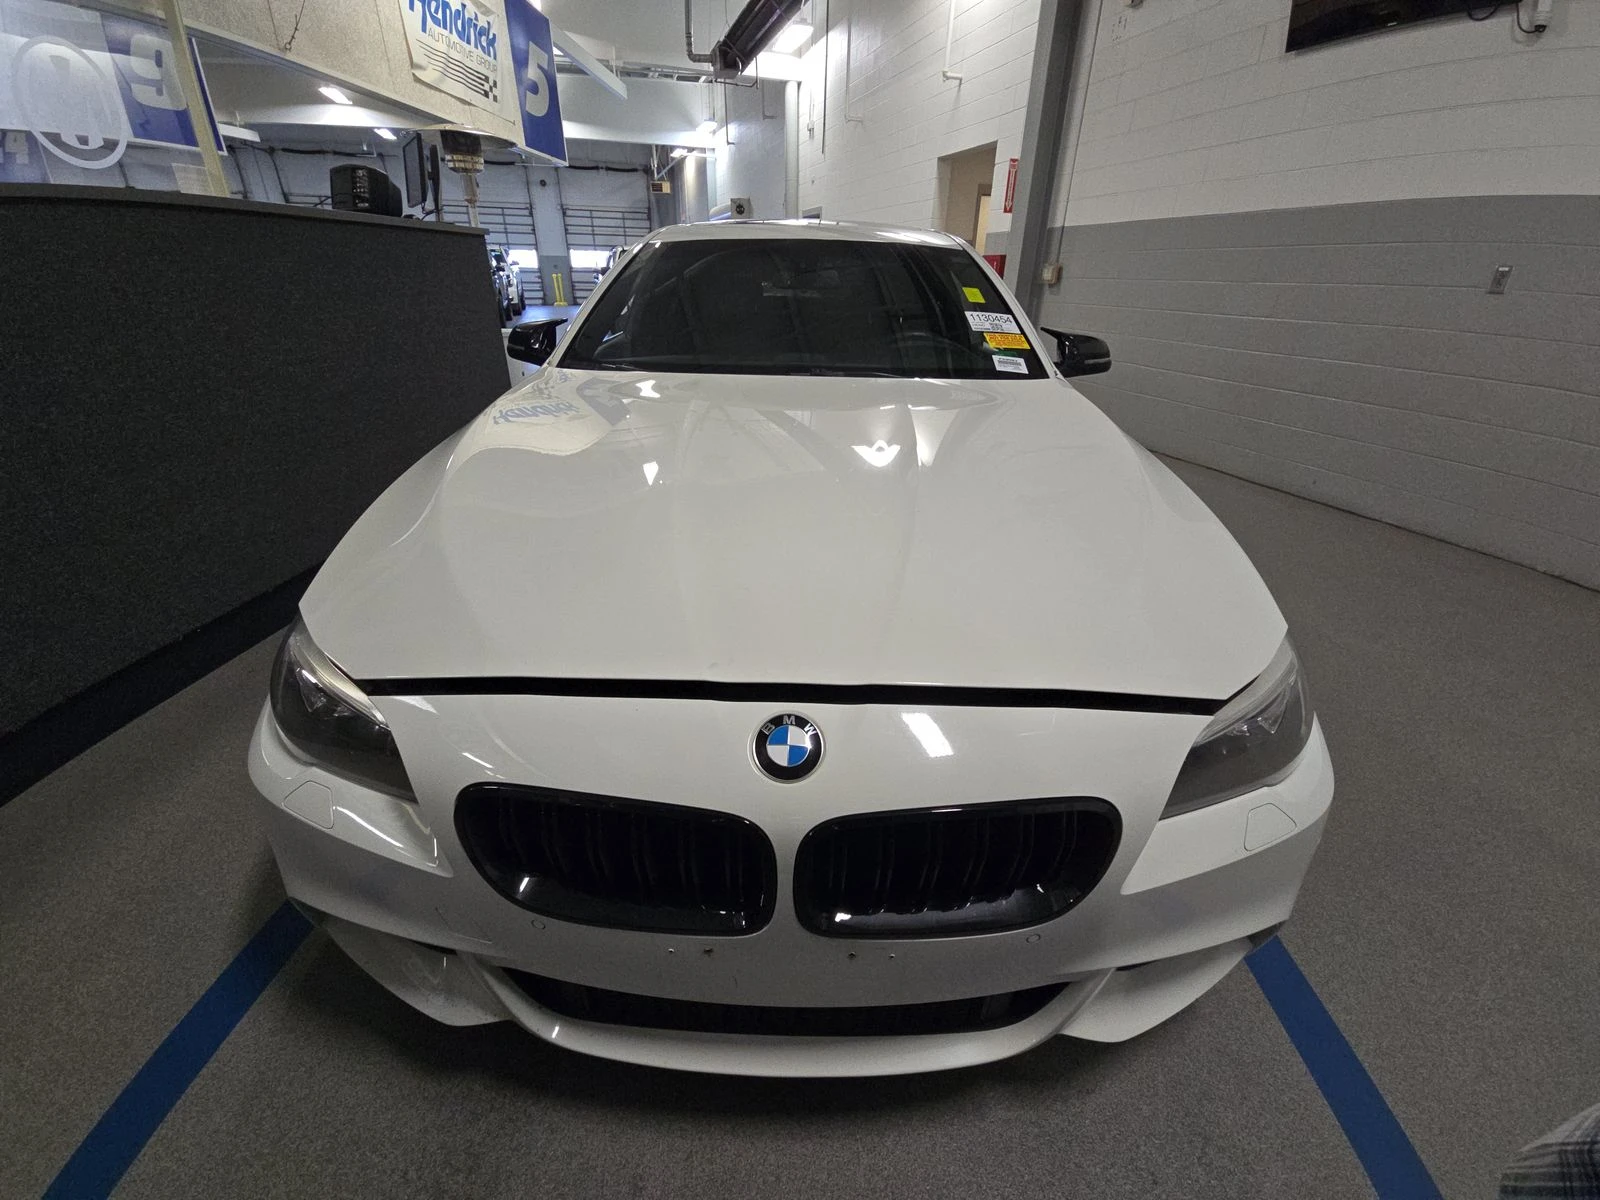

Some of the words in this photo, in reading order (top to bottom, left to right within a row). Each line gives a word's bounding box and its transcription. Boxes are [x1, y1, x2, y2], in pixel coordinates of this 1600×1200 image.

[130, 34, 187, 110] 9
[427, 27, 474, 62] AUTOMOTIVE
[475, 54, 497, 73] GROUP
[525, 41, 550, 117] 5
[970, 314, 1013, 324] 1130454
[761, 715, 818, 736] BMW
